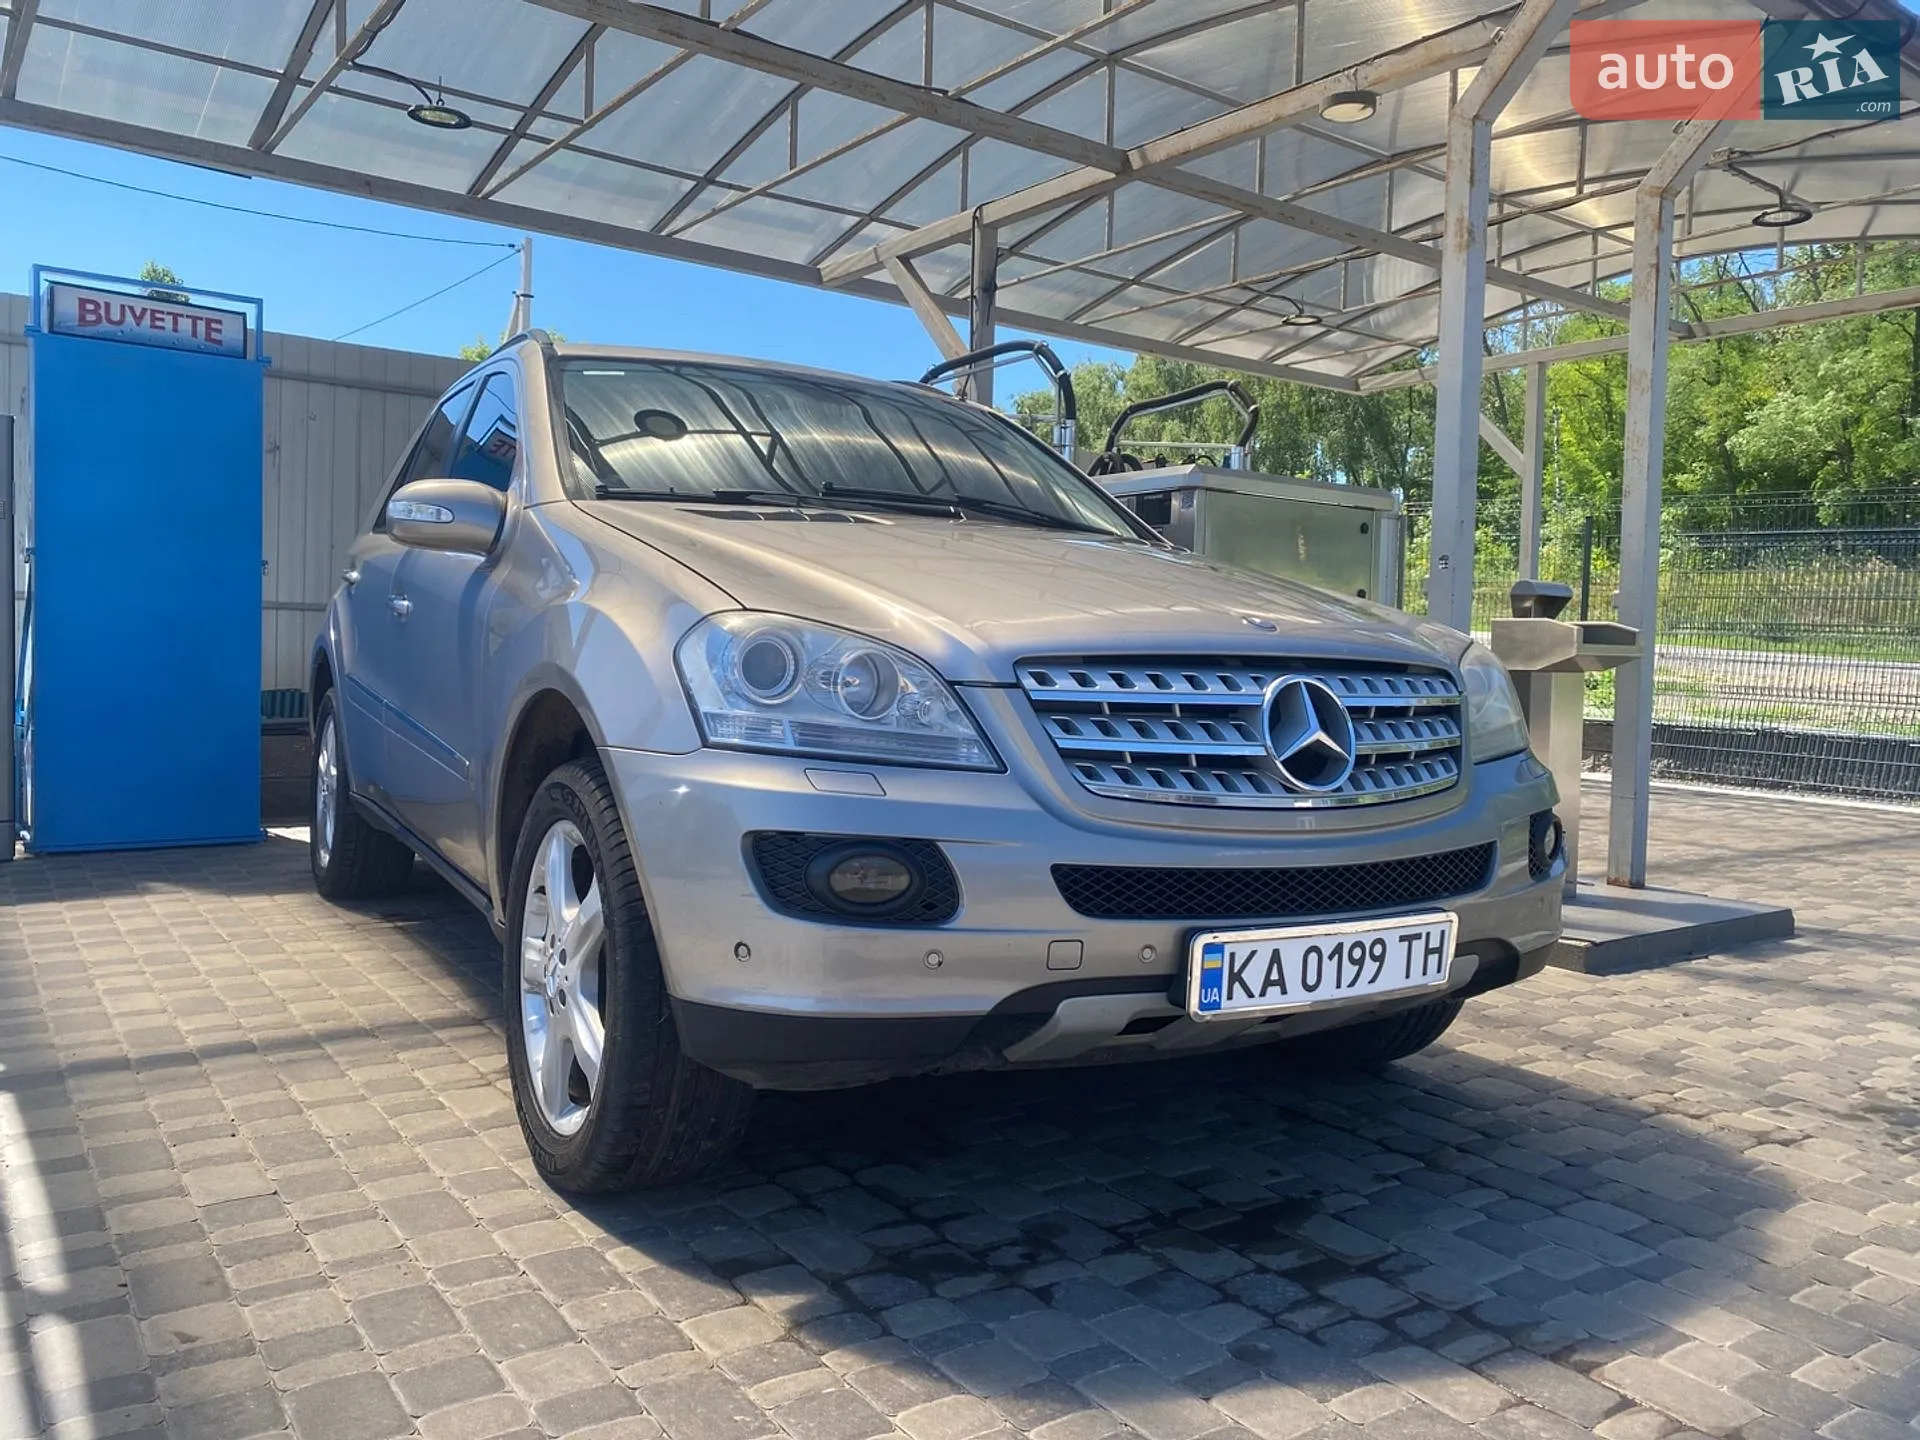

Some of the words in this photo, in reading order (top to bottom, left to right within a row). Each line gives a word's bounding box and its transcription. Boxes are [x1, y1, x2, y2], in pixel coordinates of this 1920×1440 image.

[77, 297, 223, 345] BUVETTE
[1226, 948, 1288, 1001] KA
[1301, 937, 1387, 993] 0199
[1398, 929, 1446, 980] TH
[1202, 988, 1220, 1005] UA
